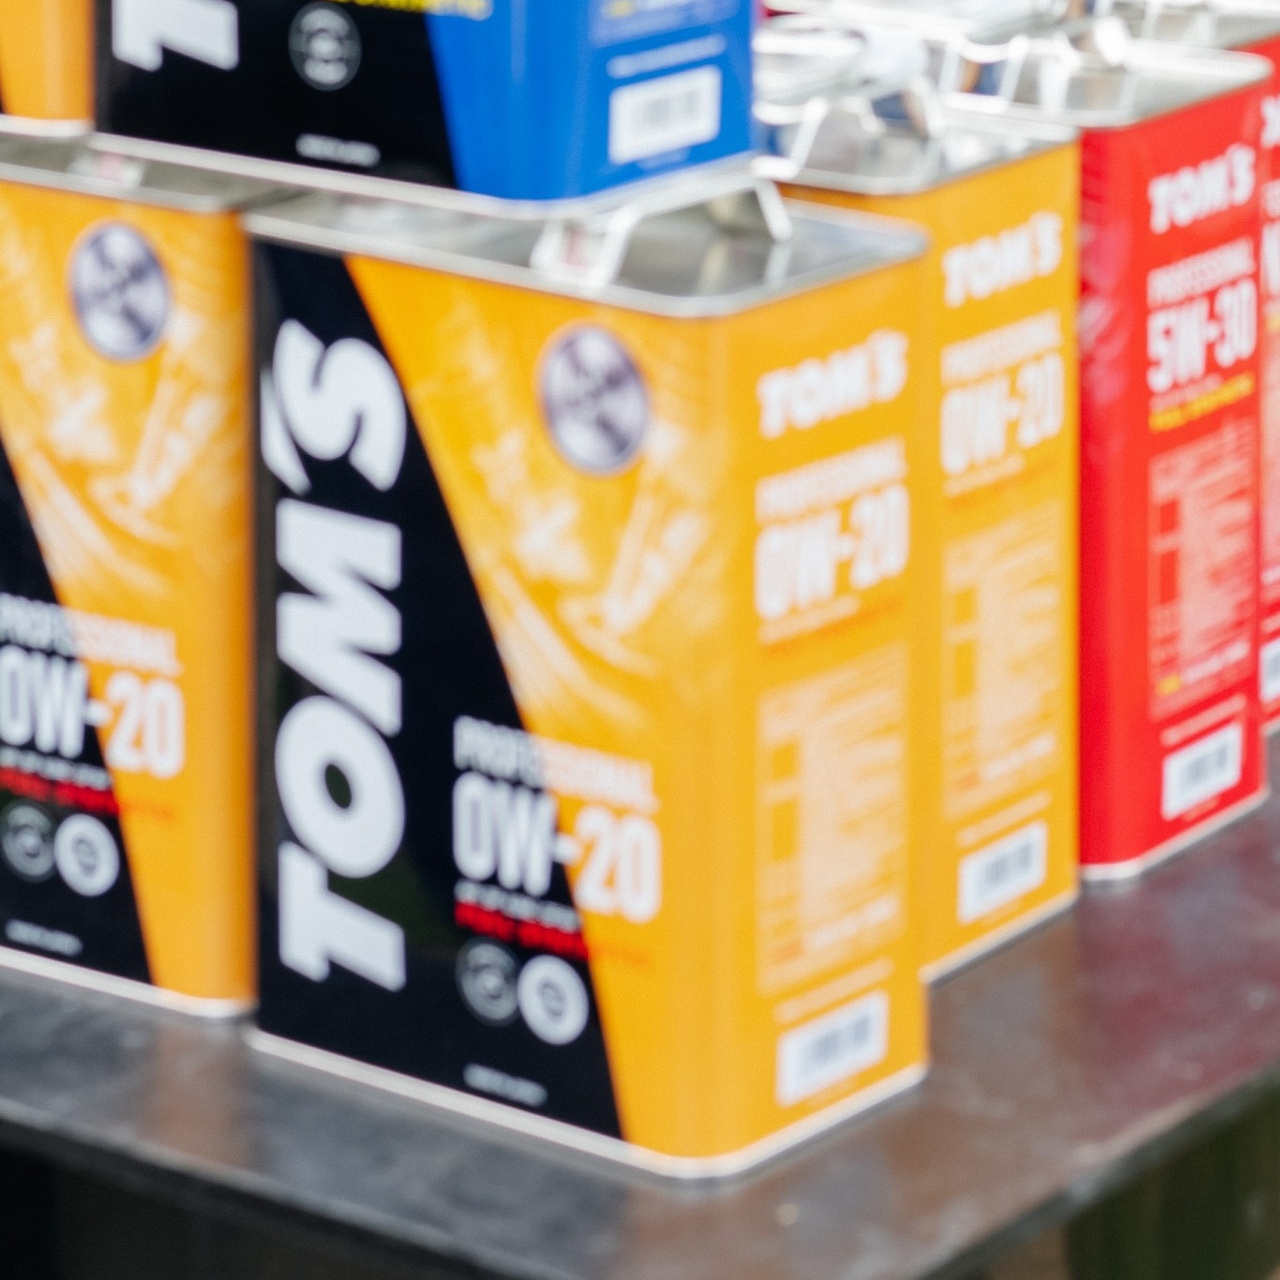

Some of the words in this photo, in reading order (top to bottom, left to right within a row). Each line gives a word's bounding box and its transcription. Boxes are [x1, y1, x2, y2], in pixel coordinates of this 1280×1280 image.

[1149, 143, 1255, 234] TOM'S
[941, 210, 1063, 309] TOM'S
[756, 327, 909, 438] TOM'S
[259, 319, 407, 992] TOM'S
[453, 771, 663, 923] 0W-20
